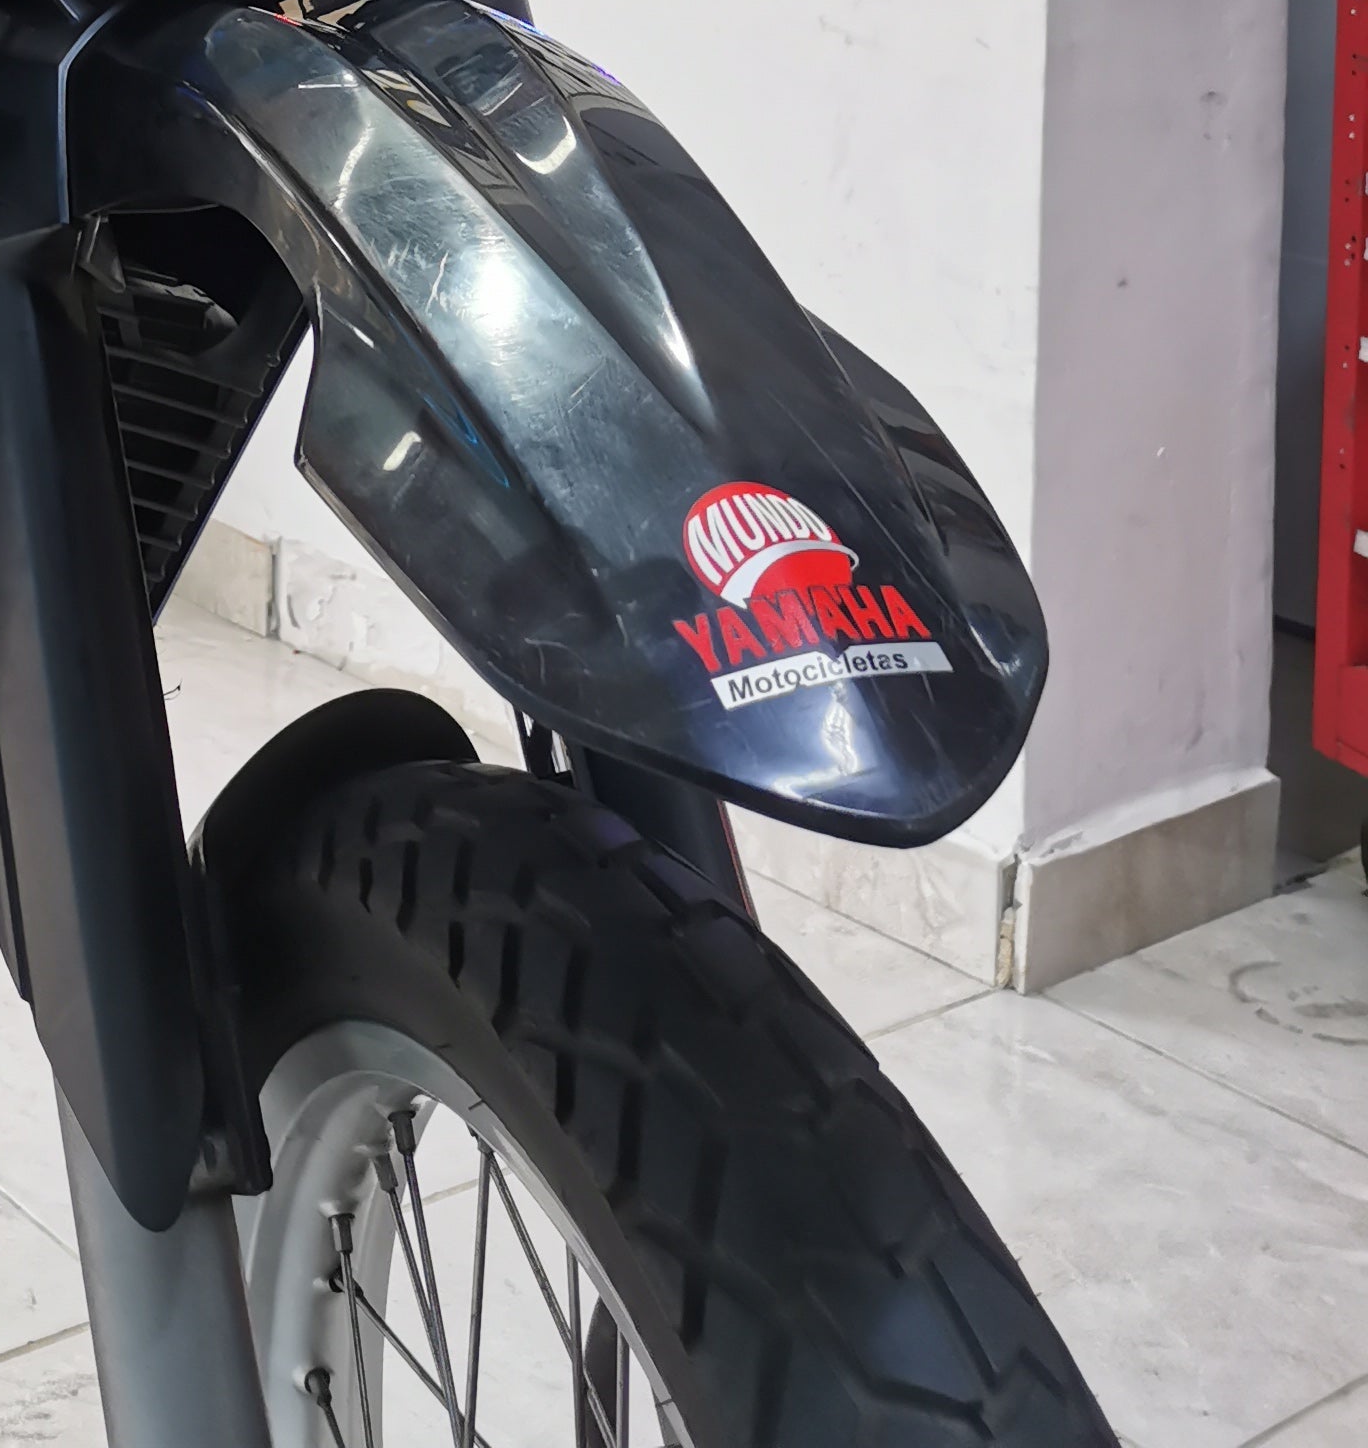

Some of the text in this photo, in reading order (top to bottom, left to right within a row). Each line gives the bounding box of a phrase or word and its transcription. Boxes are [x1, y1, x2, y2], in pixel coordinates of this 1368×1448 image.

[687, 492, 833, 586] MUNDO
[672, 584, 932, 673] YAMAHA
[727, 650, 909, 703] Motocicletas
